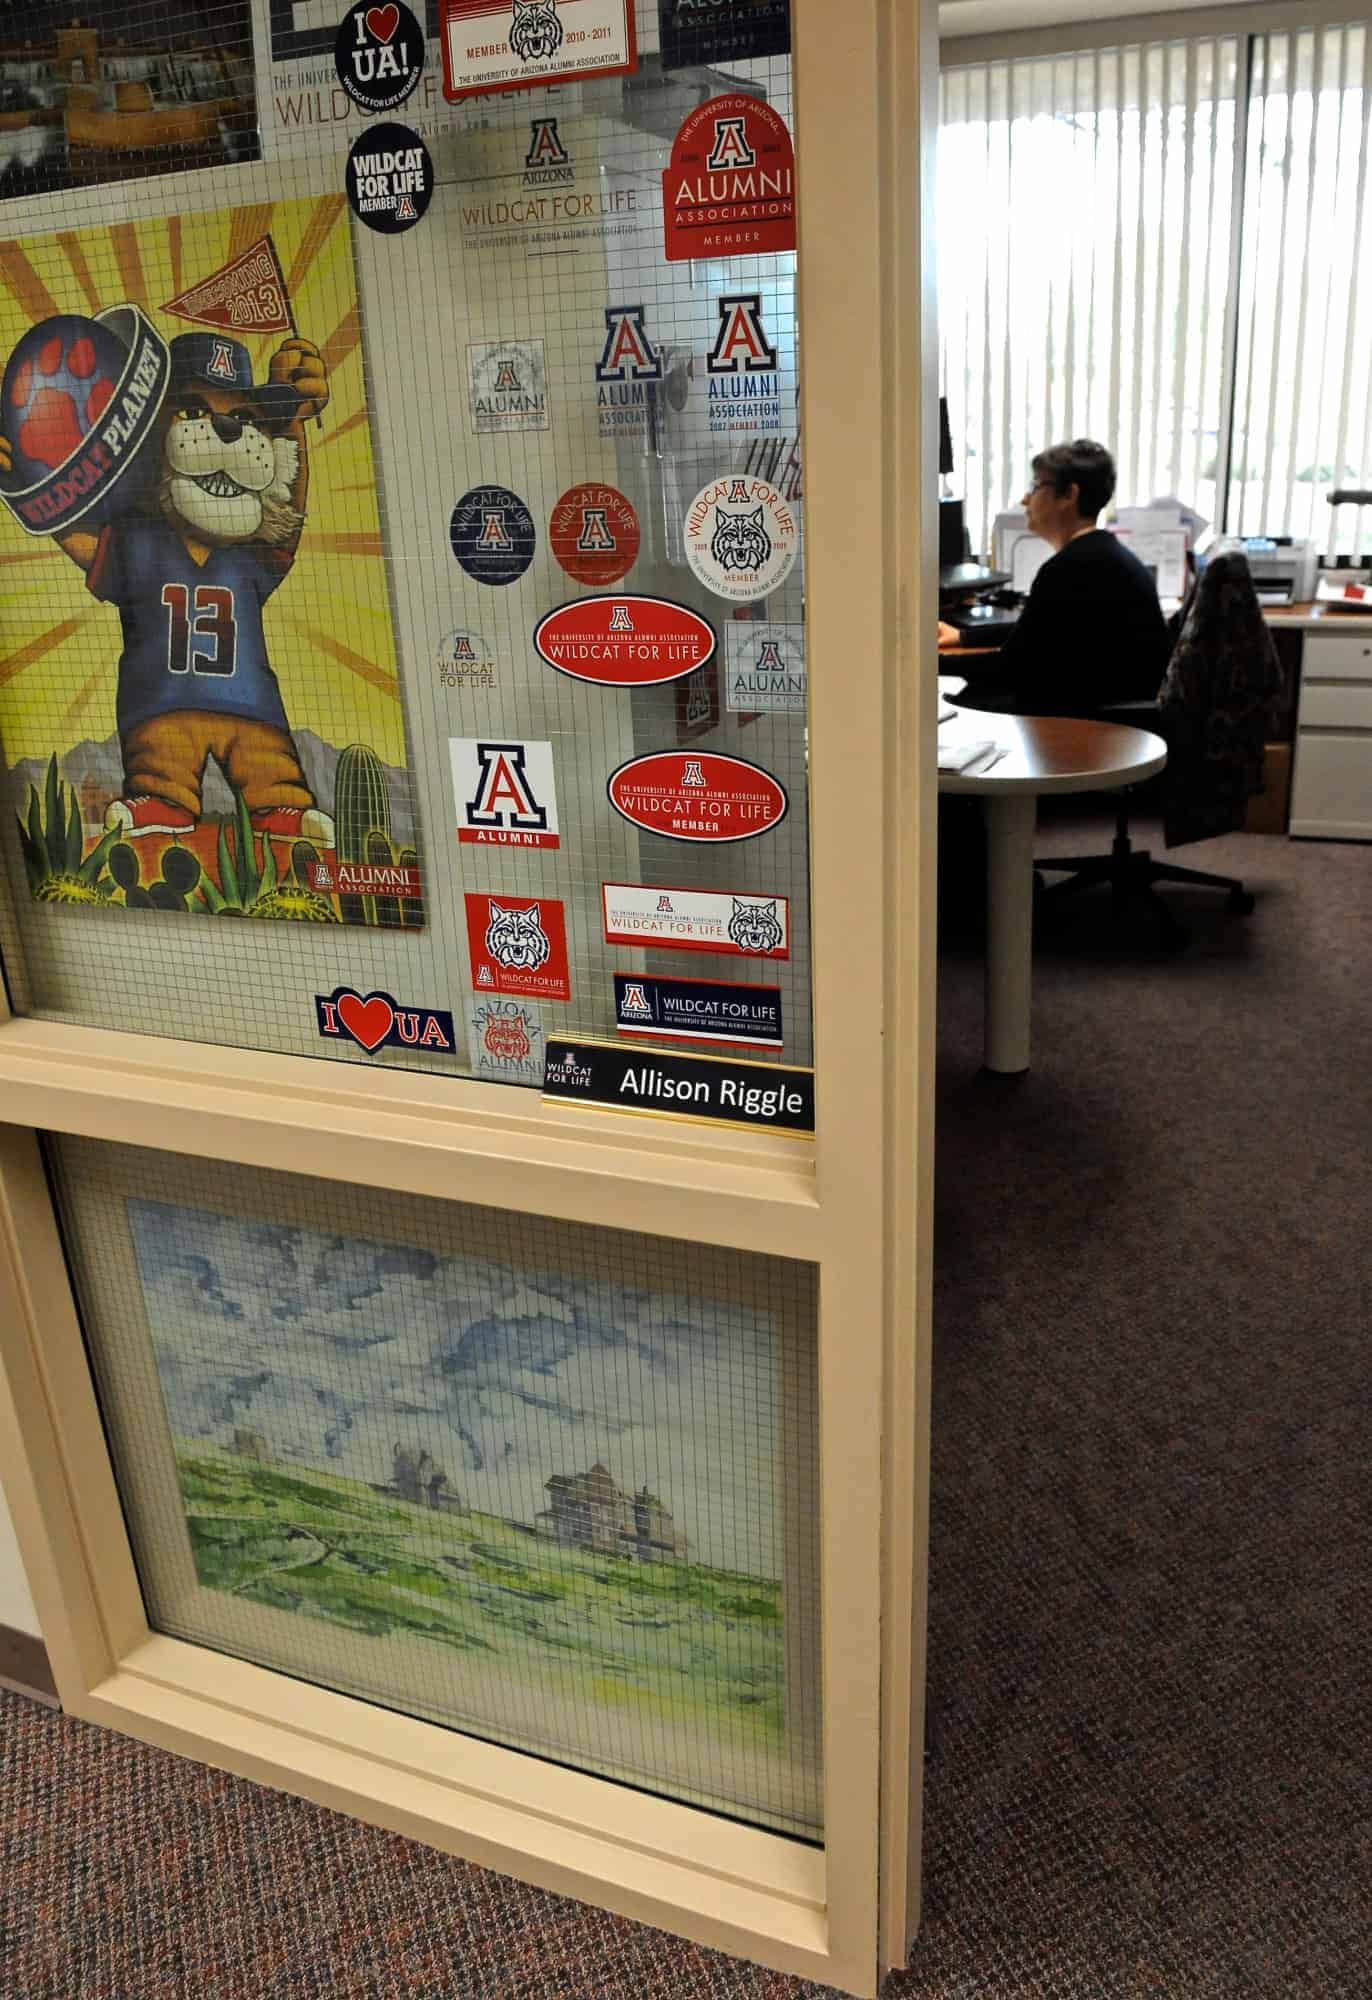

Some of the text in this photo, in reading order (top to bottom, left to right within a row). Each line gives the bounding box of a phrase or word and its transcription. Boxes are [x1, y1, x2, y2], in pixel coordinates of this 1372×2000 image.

[354, 12, 367, 45] I
[466, 43, 508, 59] MEMBER
[565, 31, 586, 44] 2010
[592, 27, 611, 41] 2011
[352, 43, 409, 82] UA!
[458, 53, 621, 85] THE UNIVERSITY OF ARIZONA ALUMNI ASSOCIATION
[298, 69, 337, 88] UNIVER
[680, 127, 694, 143] THE
[693, 100, 733, 128] UNIVERSITY
[735, 98, 747, 109] OF
[525, 117, 569, 168] A
[706, 117, 756, 172] A
[353, 148, 424, 176] WILDCAT
[522, 167, 575, 185] ARIZONA
[356, 170, 425, 199] FOR LIFE
[675, 168, 792, 206] ALUMNI
[359, 193, 418, 221] MEMBER A
[463, 198, 546, 225] WILDCAT
[553, 193, 594, 220] FOR
[675, 203, 792, 223] ASSOCIATION
[703, 231, 760, 246] MEMBER
[226, 284, 283, 325] 2013
[596, 306, 664, 381] A
[707, 295, 777, 374] A
[207, 339, 237, 381] A
[494, 360, 521, 392] A
[709, 374, 777, 399] ALUMNI
[102, 337, 161, 456] PLANET
[476, 394, 544, 414] ALUMNI
[709, 402, 778, 418] ASSOCIATION
[457, 492, 529, 534] WILDCAT FOR LIFE
[558, 491, 635, 533] WILDCAT FOR LIFE
[688, 480, 794, 538] WILDCAT A FOR LIFE
[476, 510, 513, 551] A
[577, 509, 617, 551] A
[161, 583, 238, 678] 13
[609, 606, 634, 631] A
[454, 636, 475, 660] A
[550, 645, 701, 660] WILDCAT FOR LIFE
[756, 641, 785, 671] A
[439, 662, 495, 673] WILDCAT
[440, 676, 464, 688] FOR
[465, 743, 547, 830] A
[682, 761, 706, 787] A
[620, 796, 773, 820] WILDCAT FOR LIFE
[477, 831, 540, 845] ALUMNI
[672, 819, 718, 832] MEMBER
[315, 864, 408, 885] A ALUMNI
[340, 884, 412, 895] ASSOCIATION
[656, 895, 674, 912] A
[611, 917, 724, 936] WILDCAT FOR LIFE
[500, 974, 532, 983] WILDCAT
[533, 976, 549, 985] FOR
[550, 979, 564, 987] LIFE
[620, 1011, 653, 1021] ARIZONA
[621, 984, 777, 1020] A WILDCAT FOR LIFE
[321, 1002, 449, 1047] I UA
[472, 1000, 542, 1037] ARIZONA
[547, 1063, 592, 1077] WILDCAT
[547, 1073, 592, 1087] FOR LIFE
[620, 1067, 803, 1117] Allison Riggle
